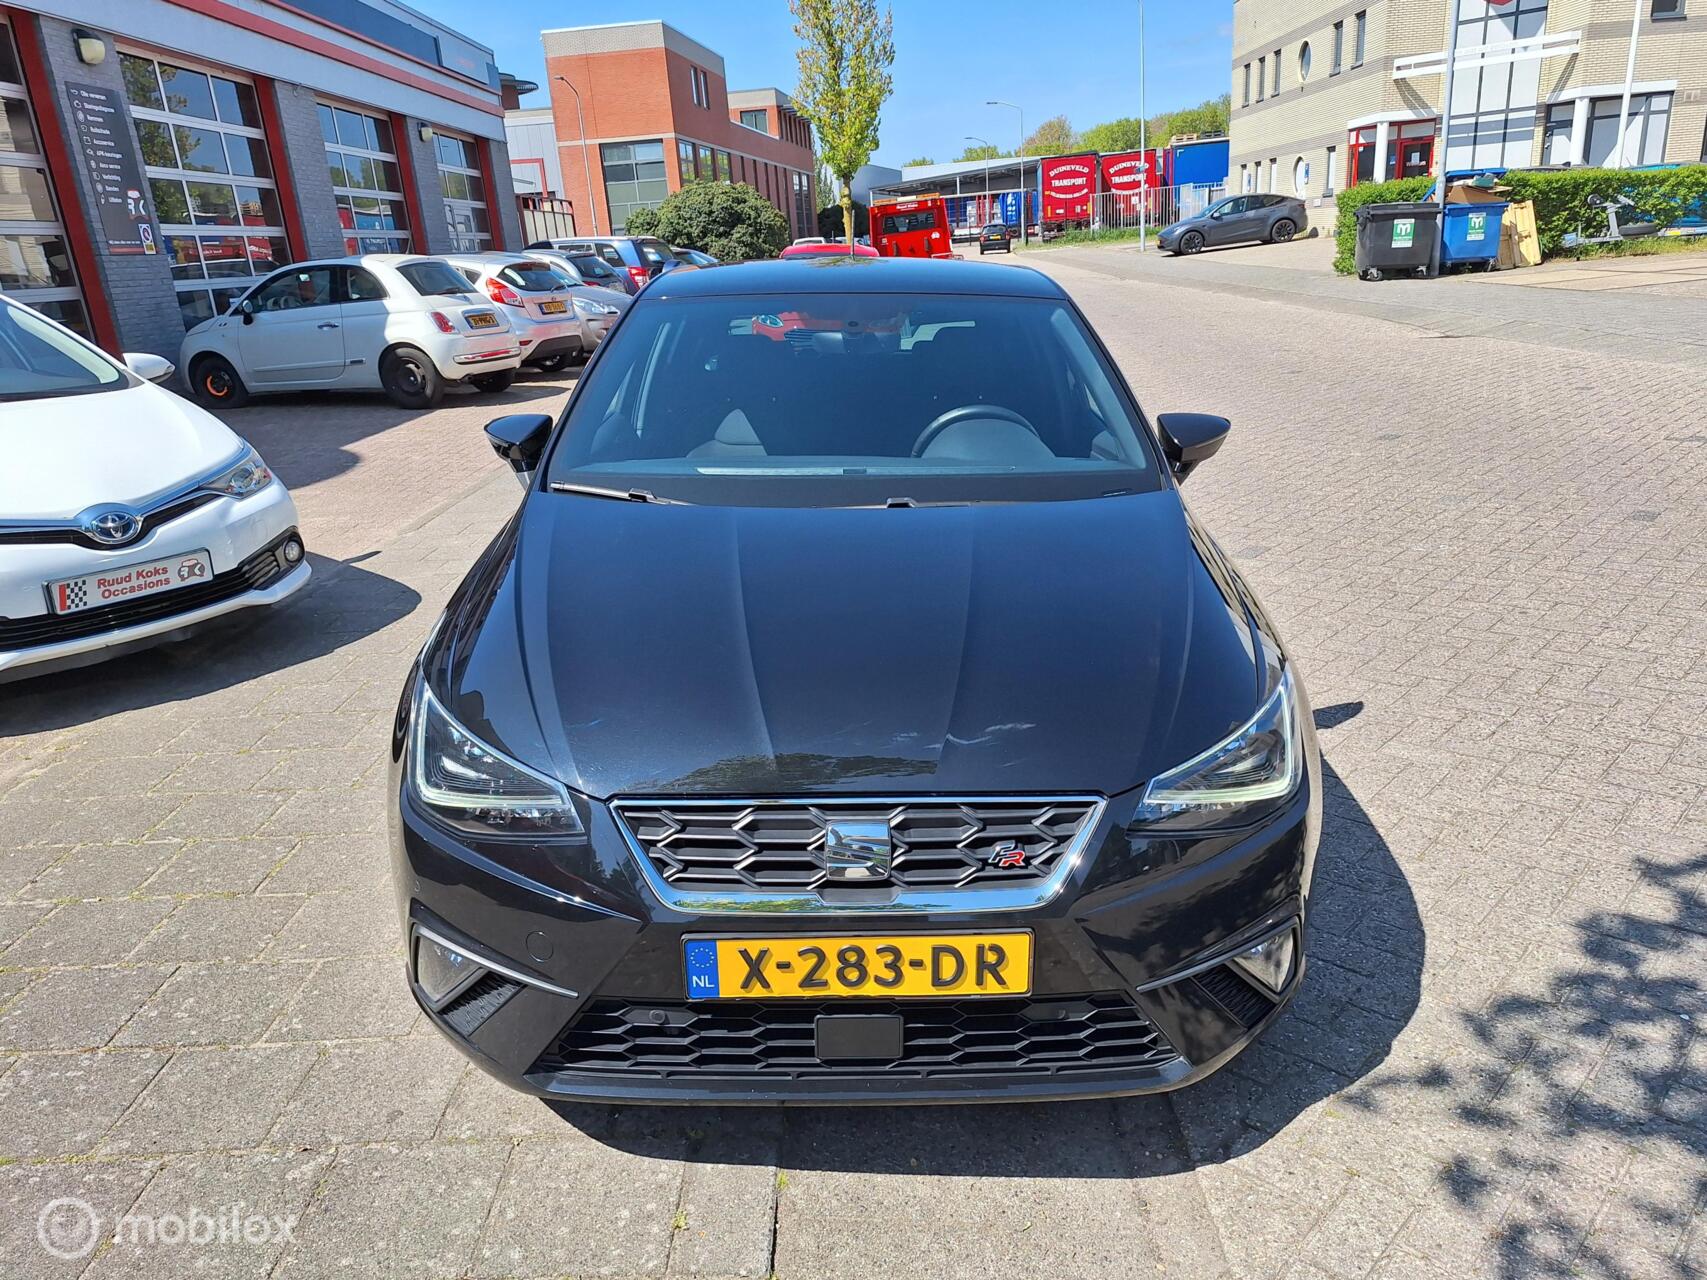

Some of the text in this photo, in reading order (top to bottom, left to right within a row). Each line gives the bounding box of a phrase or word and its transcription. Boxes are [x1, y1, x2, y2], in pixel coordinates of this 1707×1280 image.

[1049, 164, 1089, 177] DUINEVELD
[1051, 177, 1087, 187] TRANSPORT
[97, 566, 169, 589] Ruud Koks
[101, 576, 171, 599] Occasions
[738, 944, 1006, 989] X-283-DR
[692, 975, 715, 988] NL
